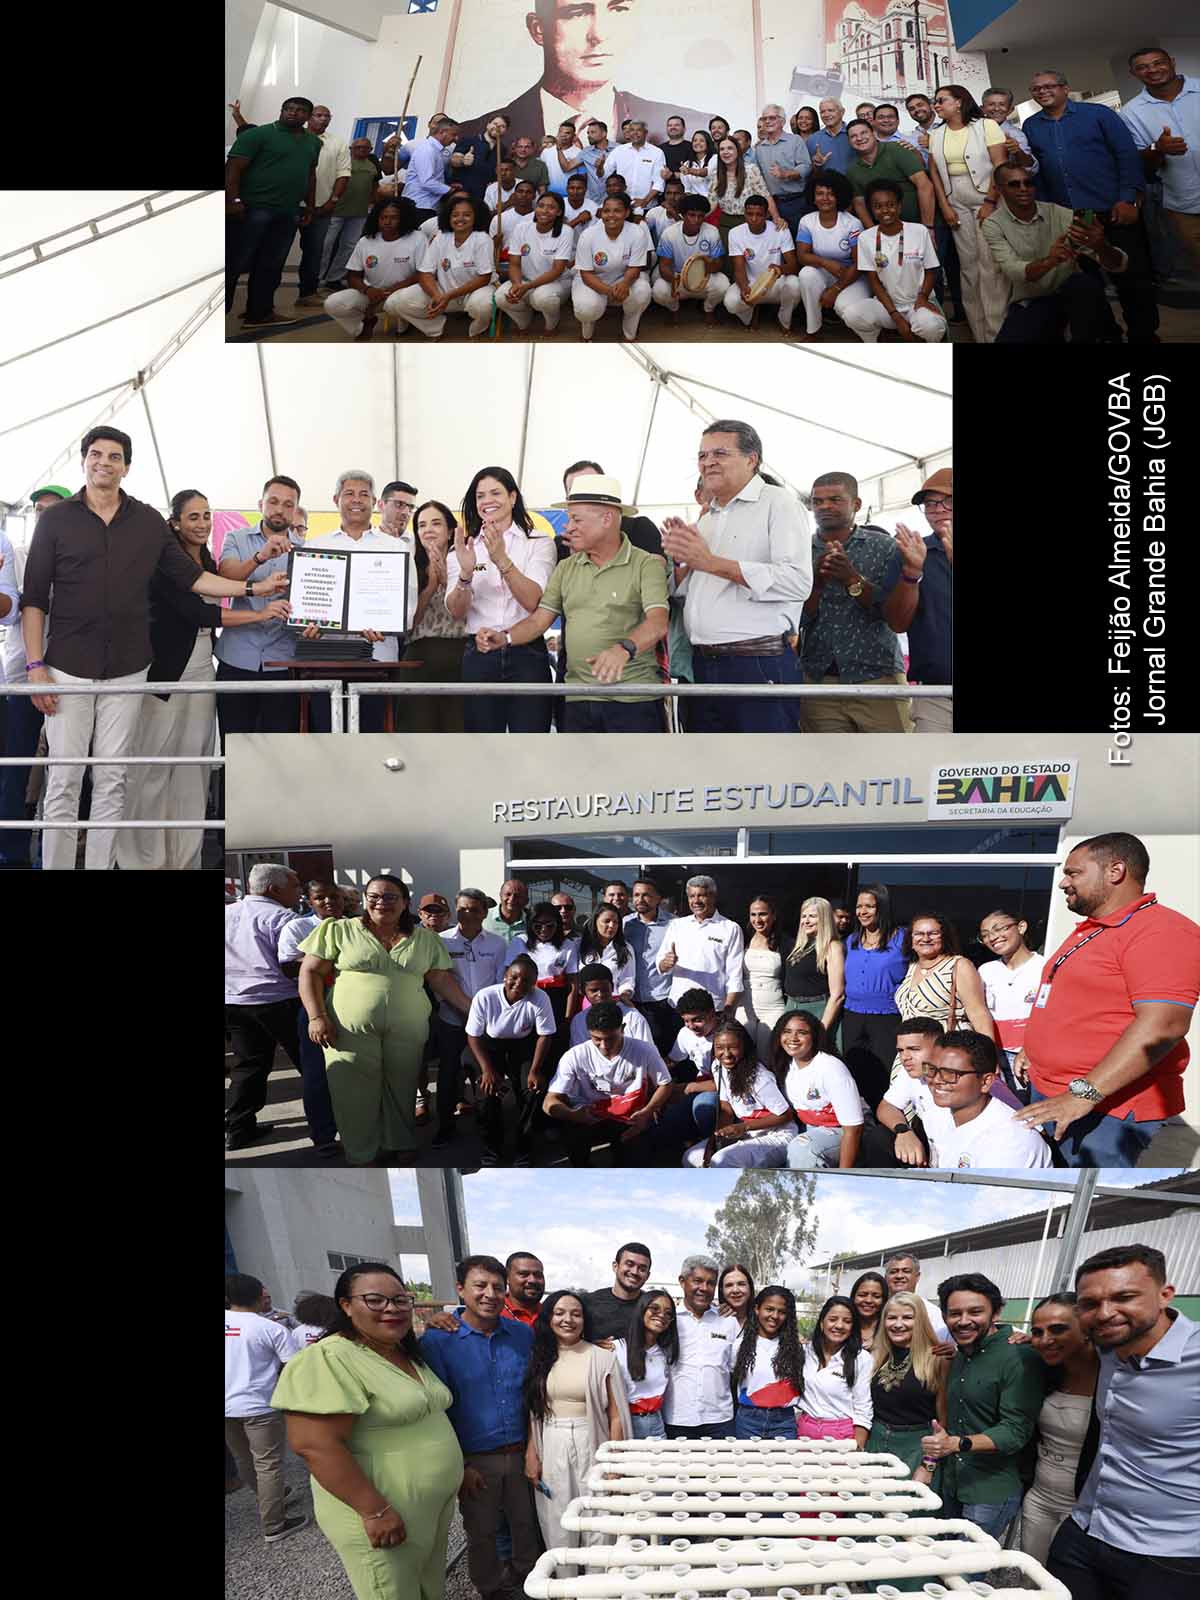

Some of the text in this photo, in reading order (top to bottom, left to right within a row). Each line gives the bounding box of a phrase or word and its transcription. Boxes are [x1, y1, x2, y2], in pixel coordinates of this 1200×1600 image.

[939, 763, 1071, 778] GOVERNO DO ESTADO
[492, 776, 924, 823] RESTAURANTE ESTUDANTIL
[936, 774, 1067, 805] BAHIA
[949, 807, 996, 815] SECRETARIA
[1010, 805, 1053, 814] EDUCAÇÃO
